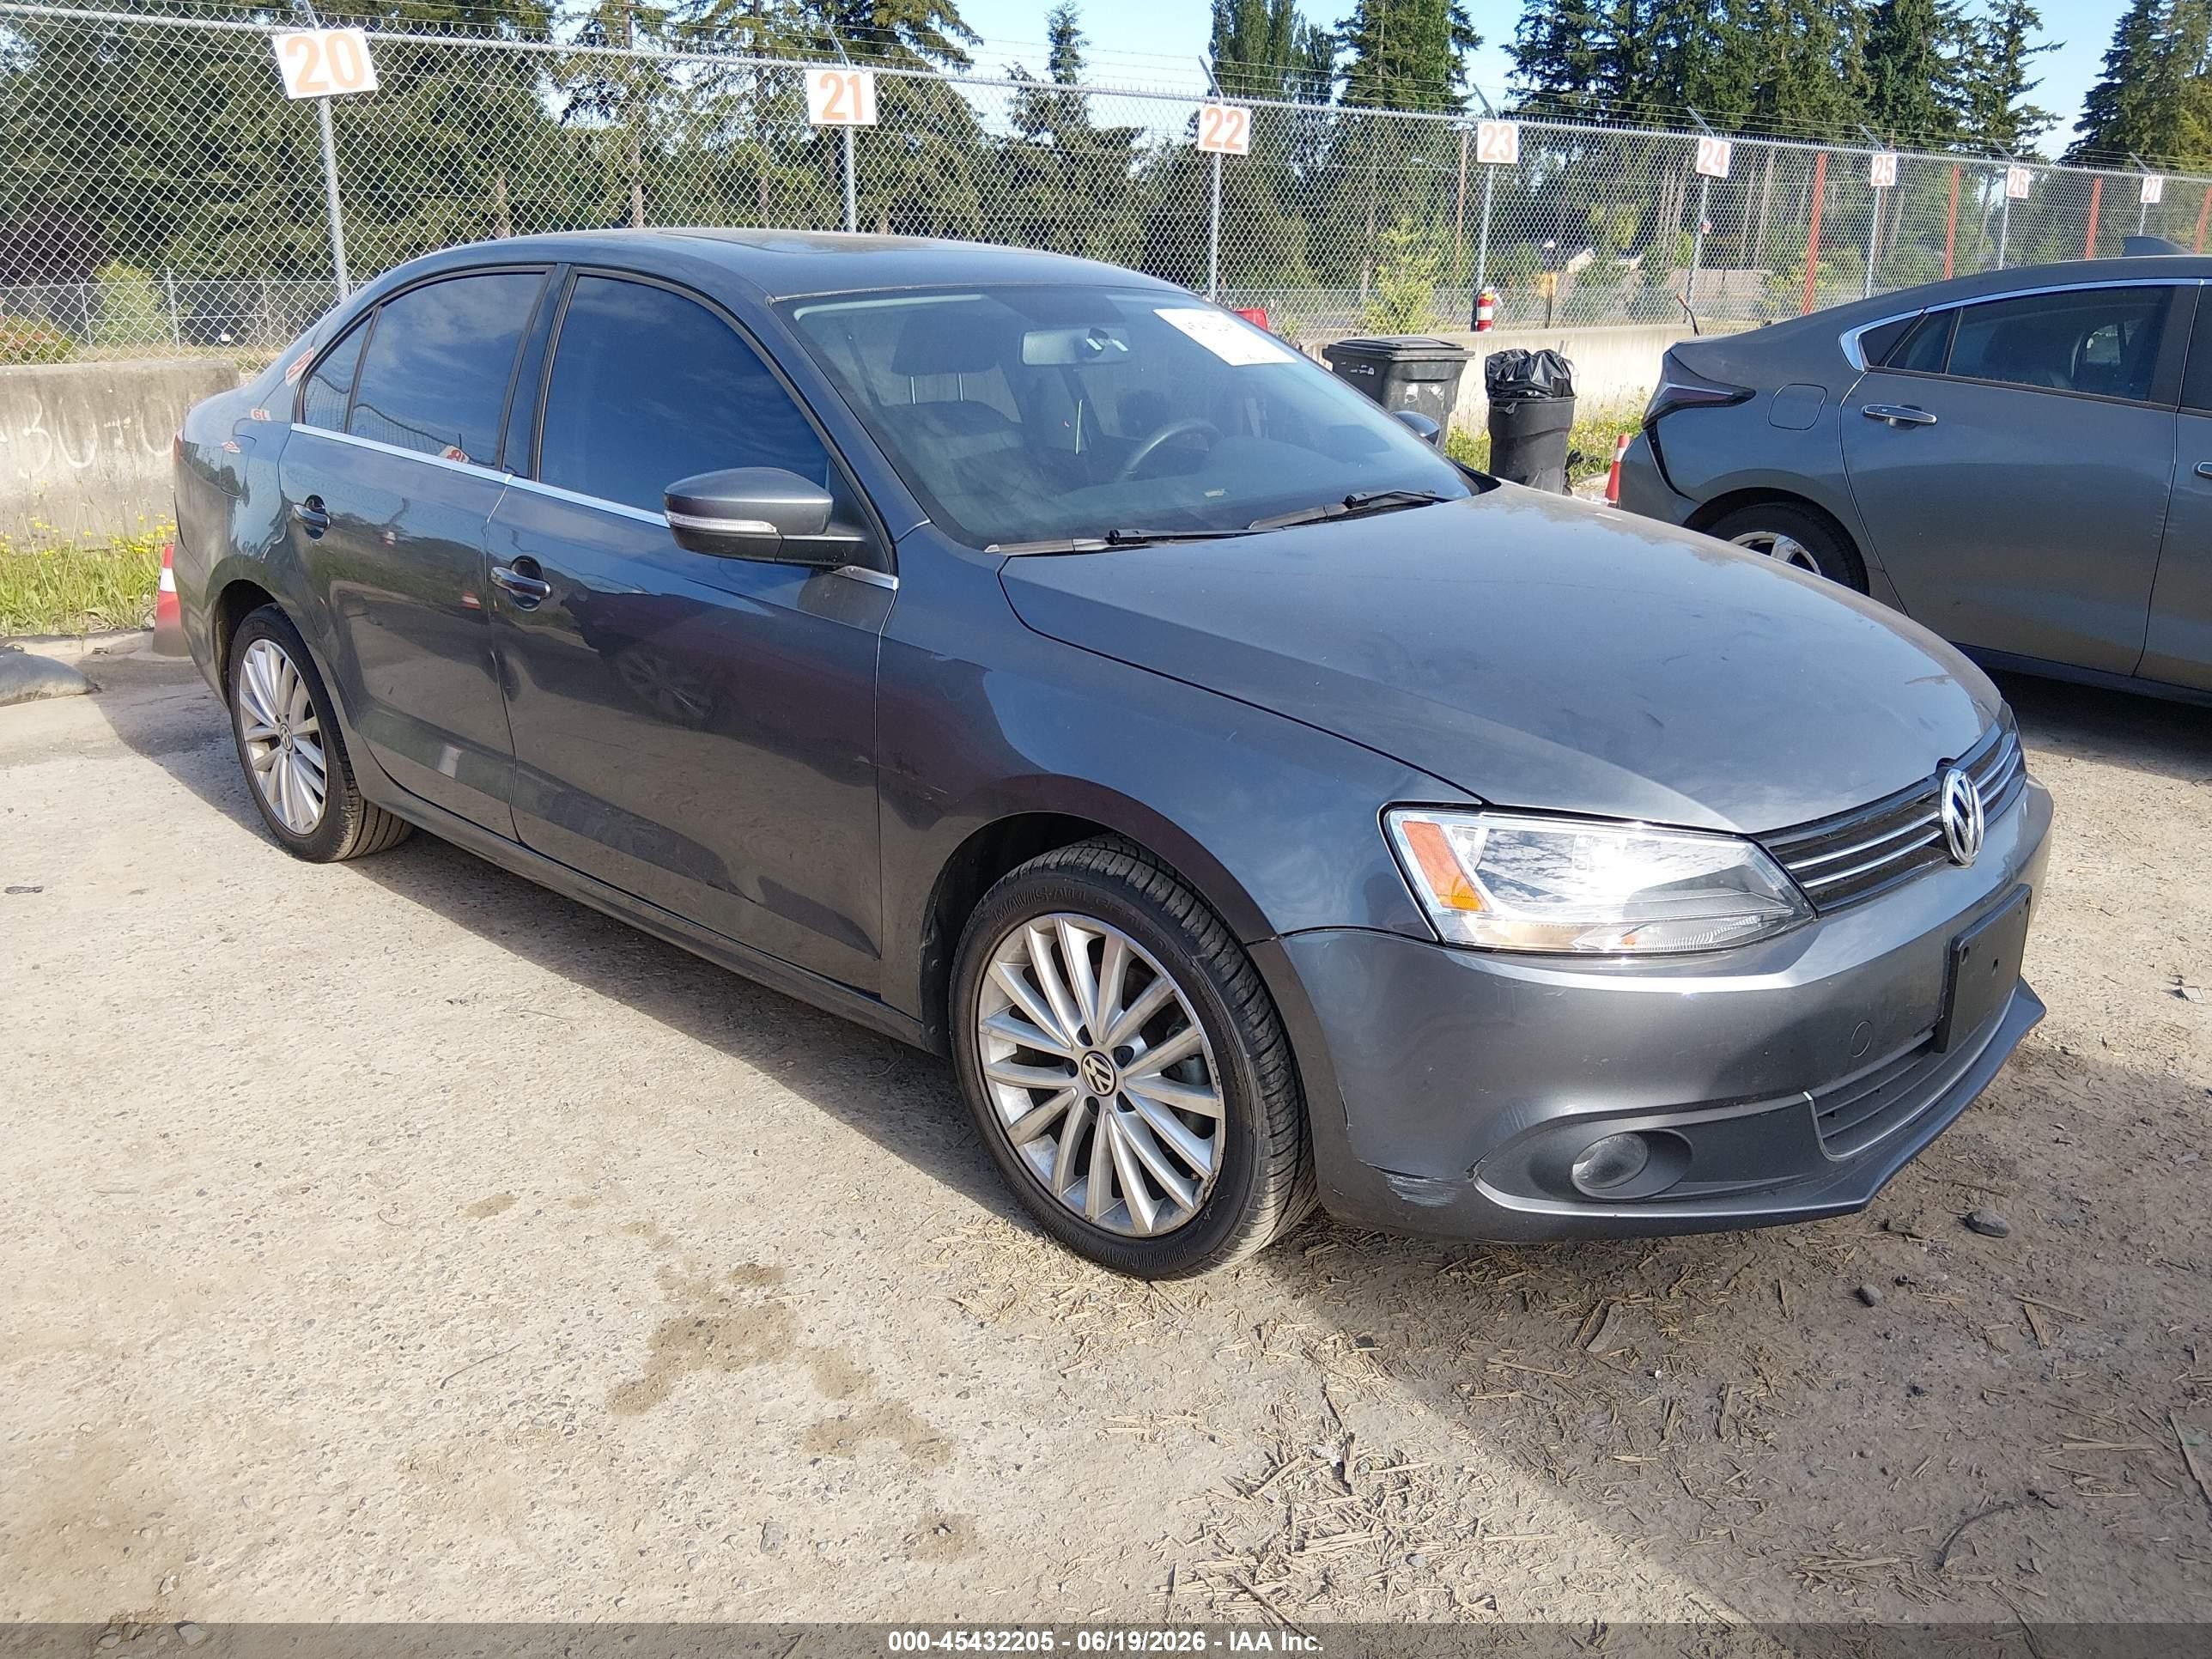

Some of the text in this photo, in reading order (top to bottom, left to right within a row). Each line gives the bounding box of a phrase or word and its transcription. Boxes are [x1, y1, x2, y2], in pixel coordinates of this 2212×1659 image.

[285, 33, 366, 93] 20
[819, 72, 864, 121] 21
[1203, 106, 1245, 151] 22
[1481, 124, 1514, 162] 23
[1699, 142, 1727, 174] 24
[1873, 157, 1894, 185] 25
[2008, 172, 2028, 197] 26
[2144, 178, 2160, 202] 27
